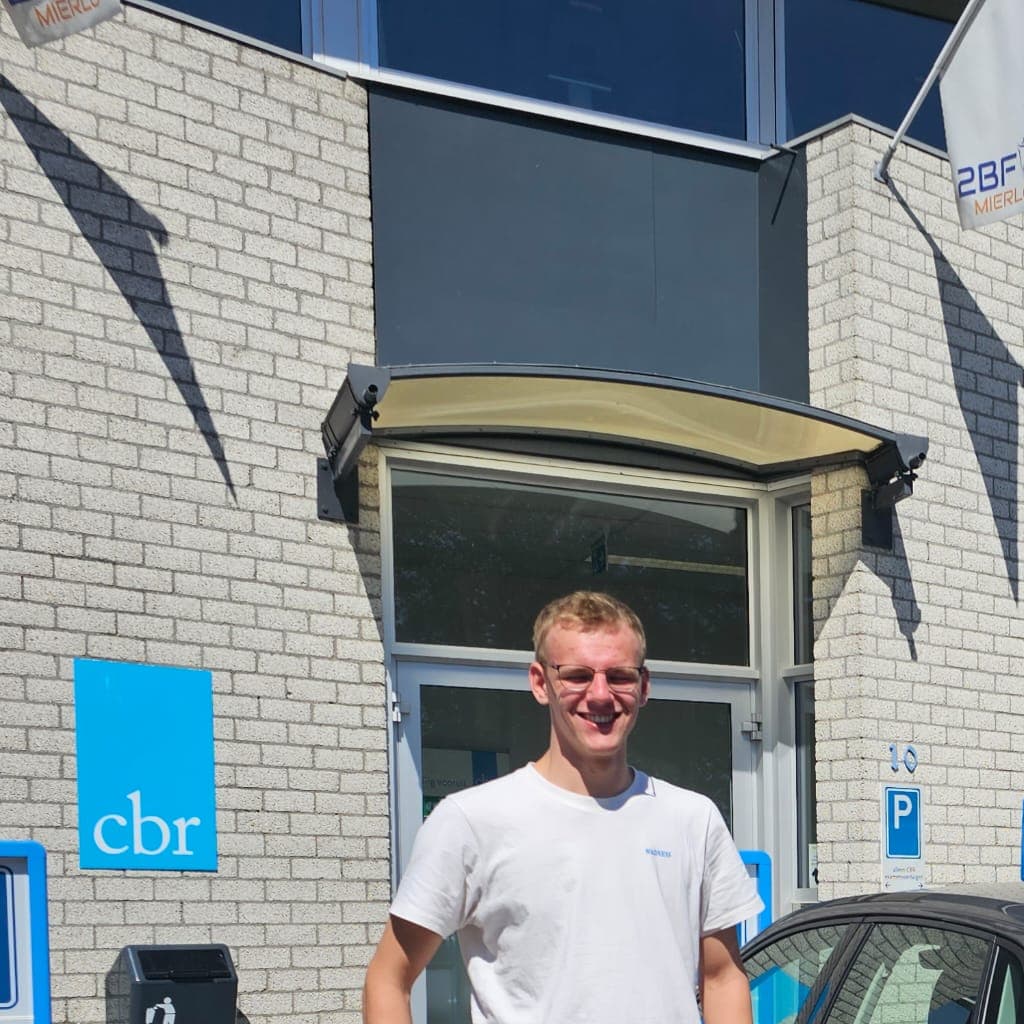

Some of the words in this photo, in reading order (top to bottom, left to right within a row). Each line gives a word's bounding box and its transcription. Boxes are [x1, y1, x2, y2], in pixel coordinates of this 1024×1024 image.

[889, 743, 918, 774] 10
[93, 789, 201, 856] cbr
[893, 794, 913, 830] P
